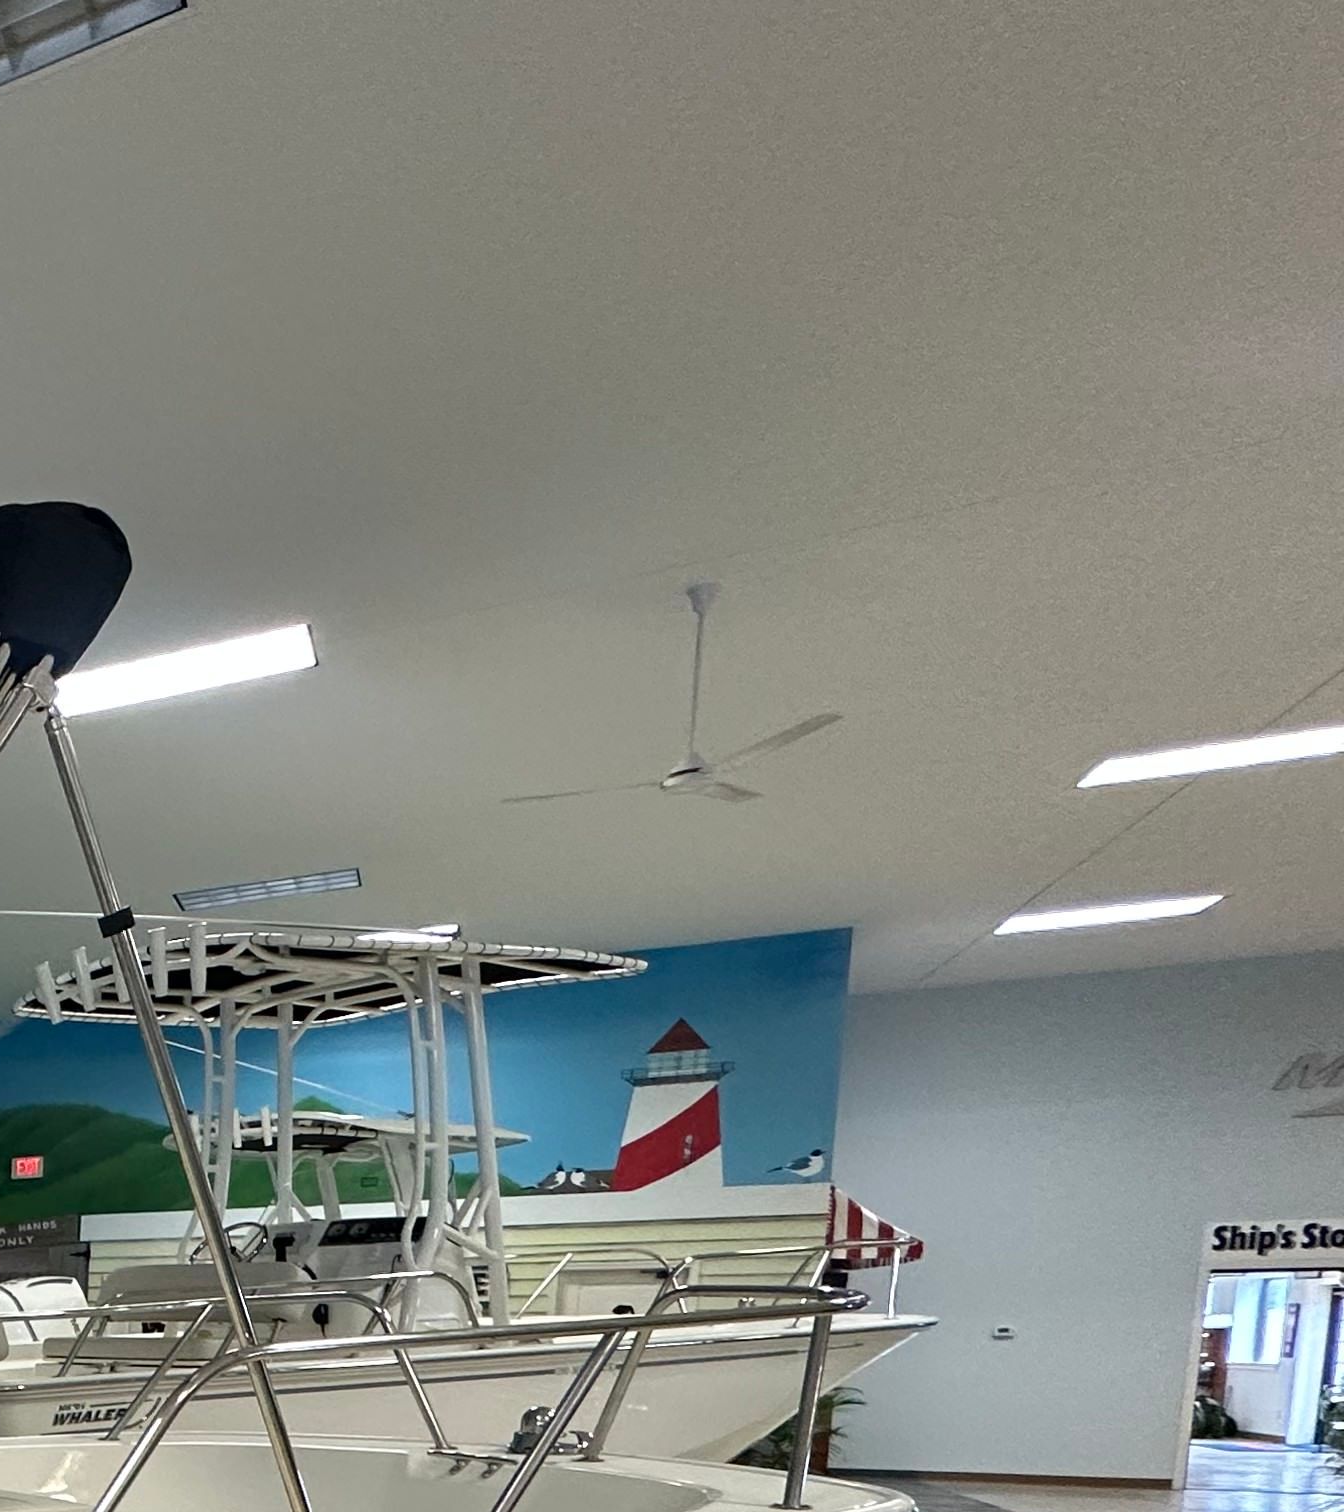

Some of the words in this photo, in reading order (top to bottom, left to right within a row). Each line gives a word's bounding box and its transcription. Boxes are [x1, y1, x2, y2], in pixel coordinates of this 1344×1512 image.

[18, 1220, 57, 1231] HANDS
[1212, 1223, 1297, 1257] Ship's
[1300, 1222, 1344, 1250] Sto
